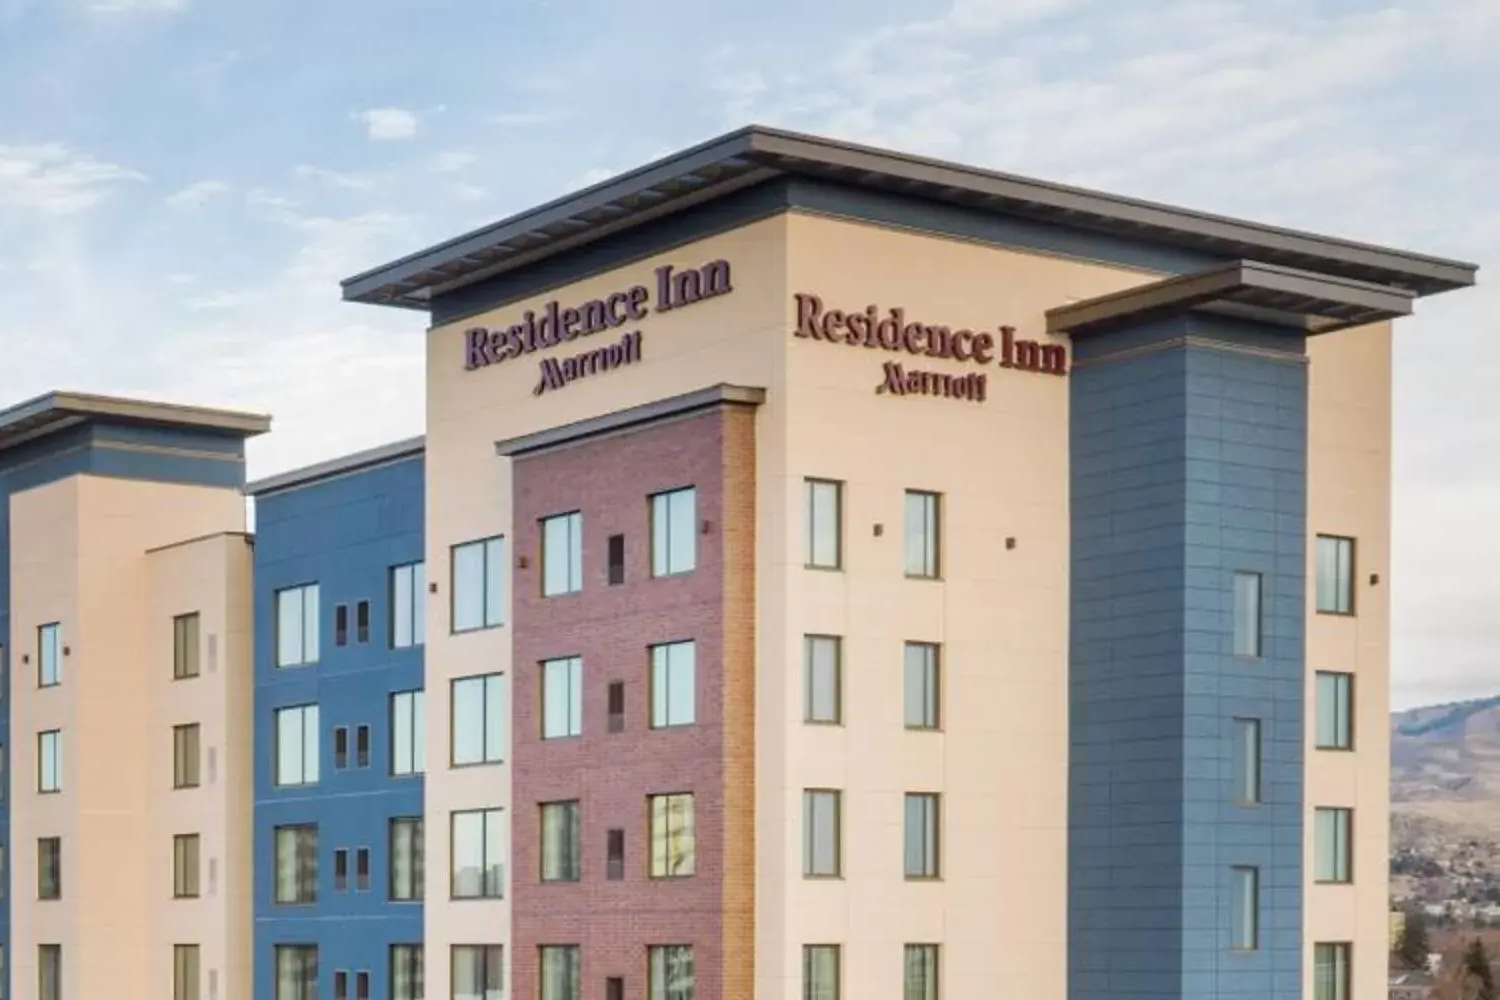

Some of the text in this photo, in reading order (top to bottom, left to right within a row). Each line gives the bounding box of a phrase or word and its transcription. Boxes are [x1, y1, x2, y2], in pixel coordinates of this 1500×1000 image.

[465, 259, 734, 370] Residence Inn
[793, 292, 1067, 377] Residence Inn
[532, 331, 643, 397] Marriott
[875, 361, 987, 403] Marriott
